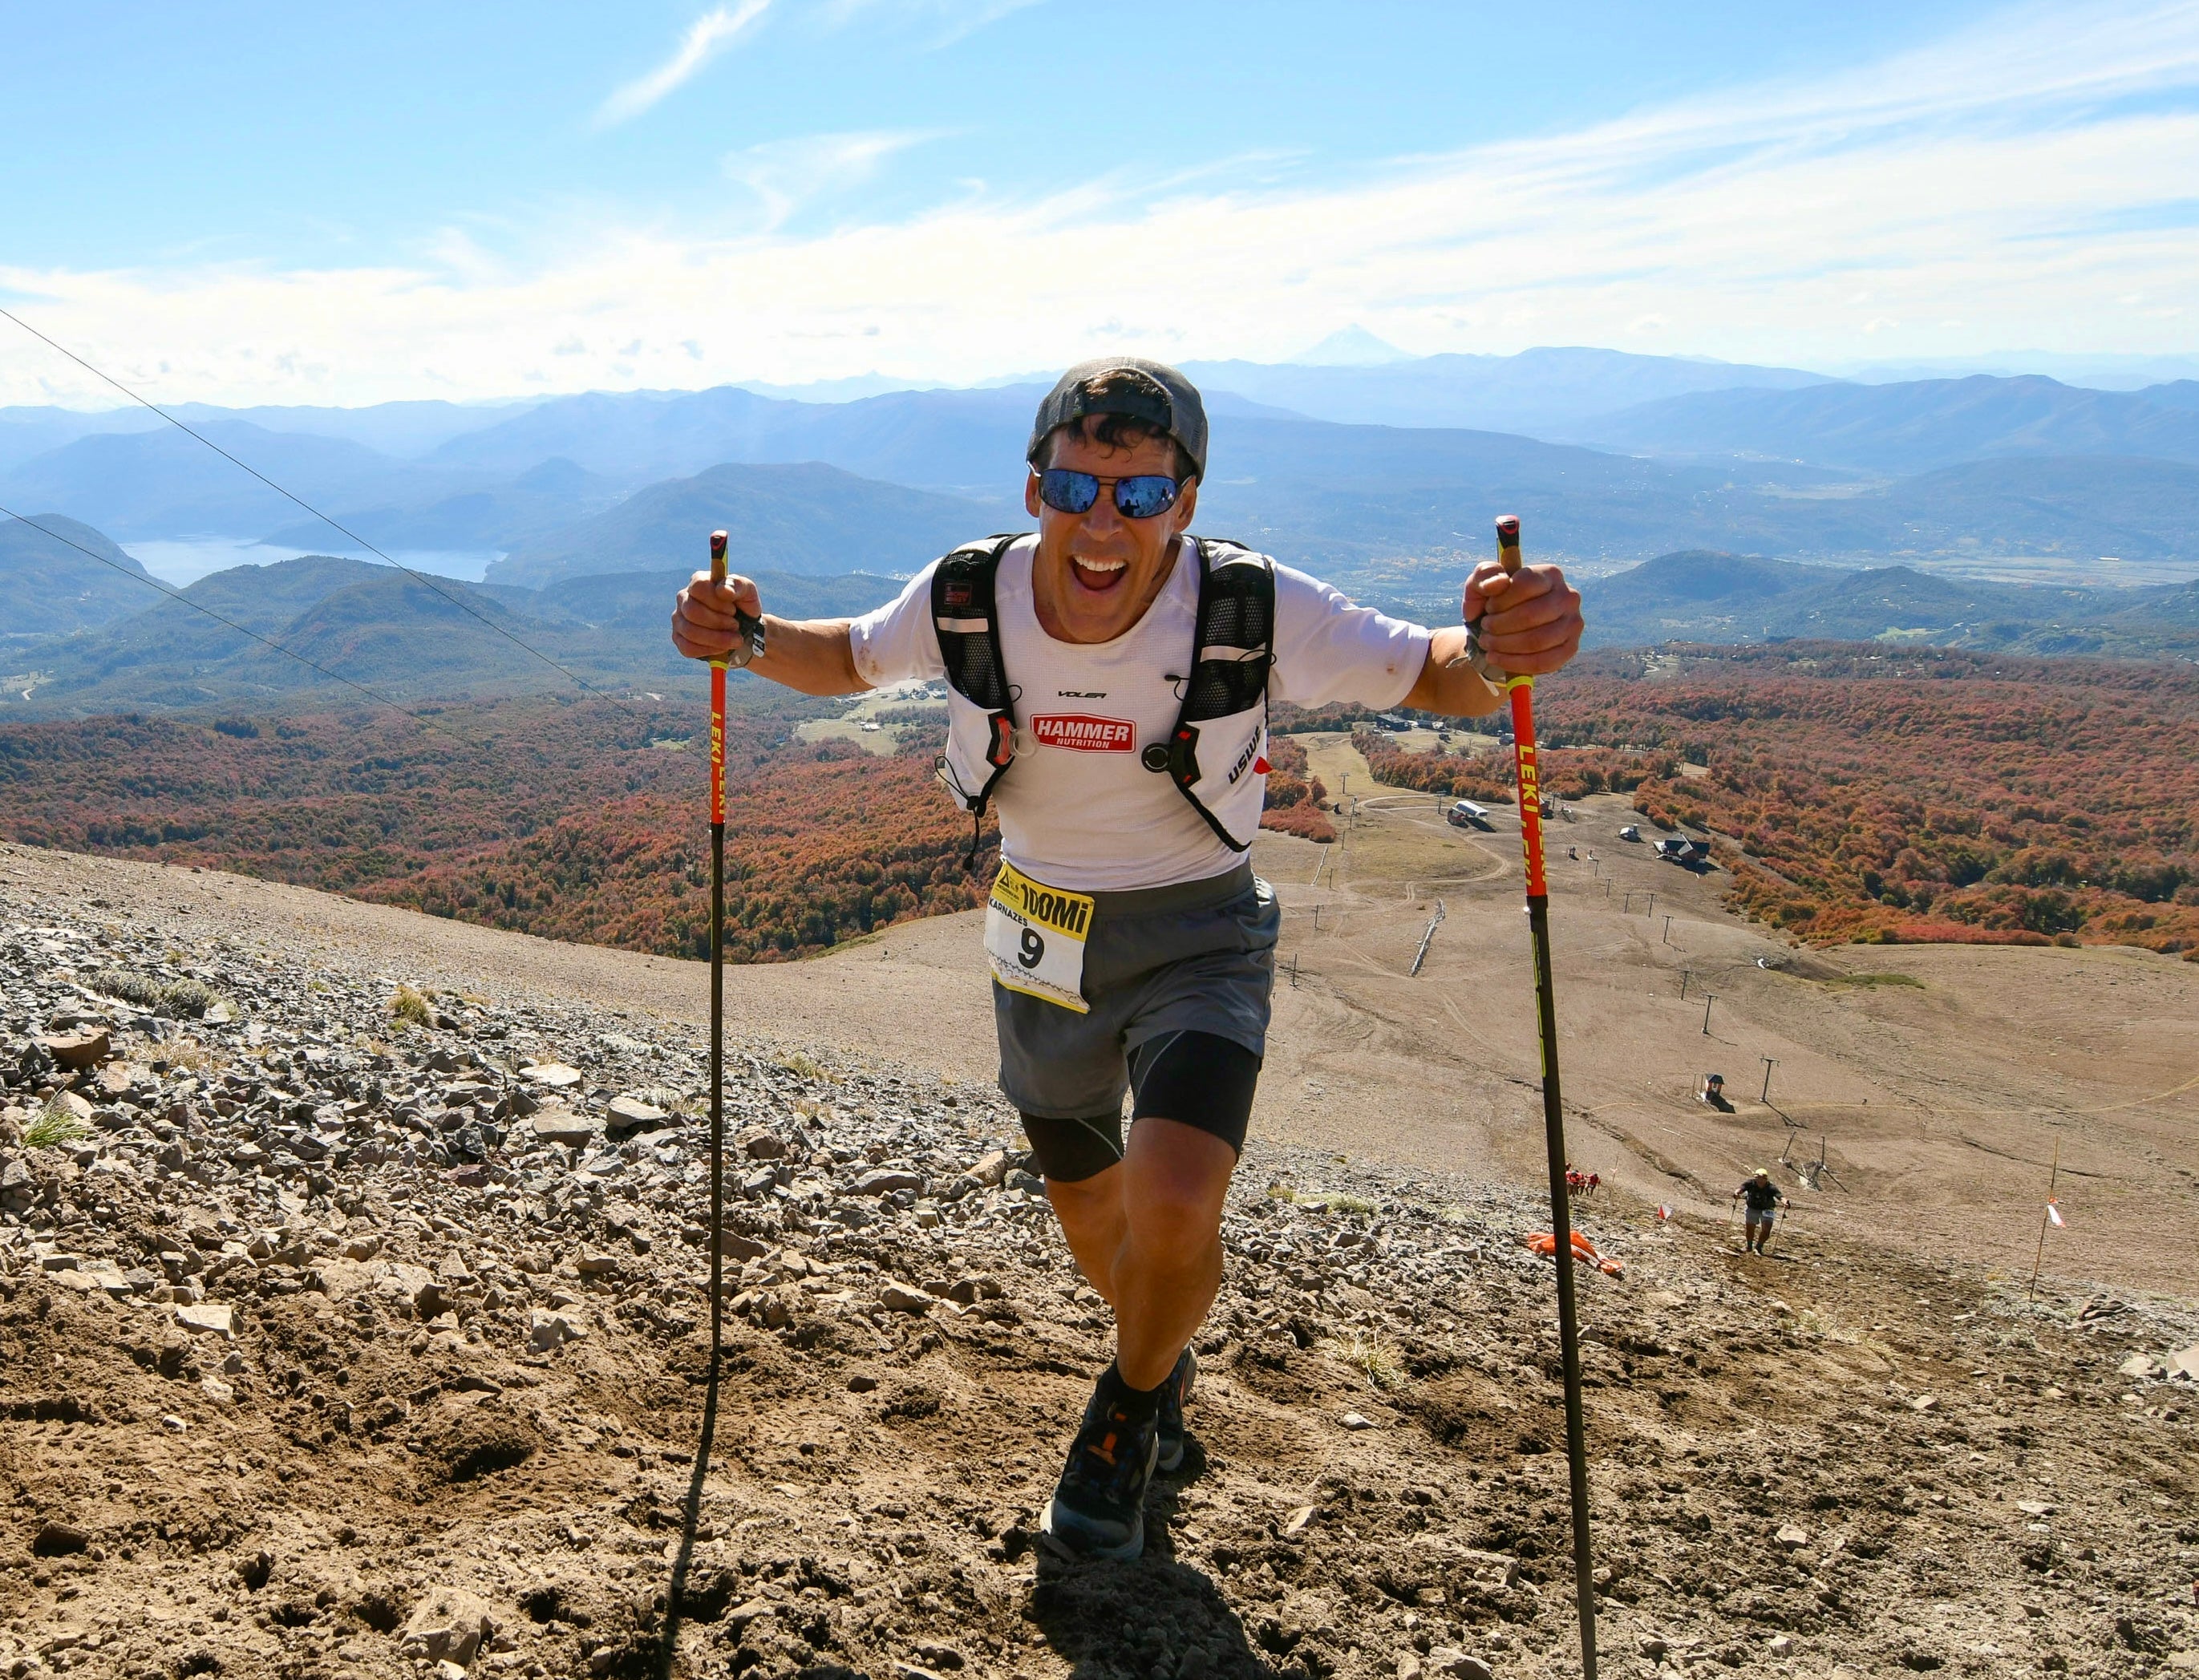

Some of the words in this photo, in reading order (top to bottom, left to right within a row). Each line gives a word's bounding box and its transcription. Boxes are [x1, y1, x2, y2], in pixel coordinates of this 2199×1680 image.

[1057, 690, 1107, 699] VOLER
[711, 711, 721, 763] LEKI
[1037, 719, 1131, 742] HAMMER
[1055, 736, 1111, 750] NUTRITION
[1519, 745, 1538, 812] LEKI
[988, 897, 1028, 927] KARNAZES
[1017, 927, 1045, 969] 9
